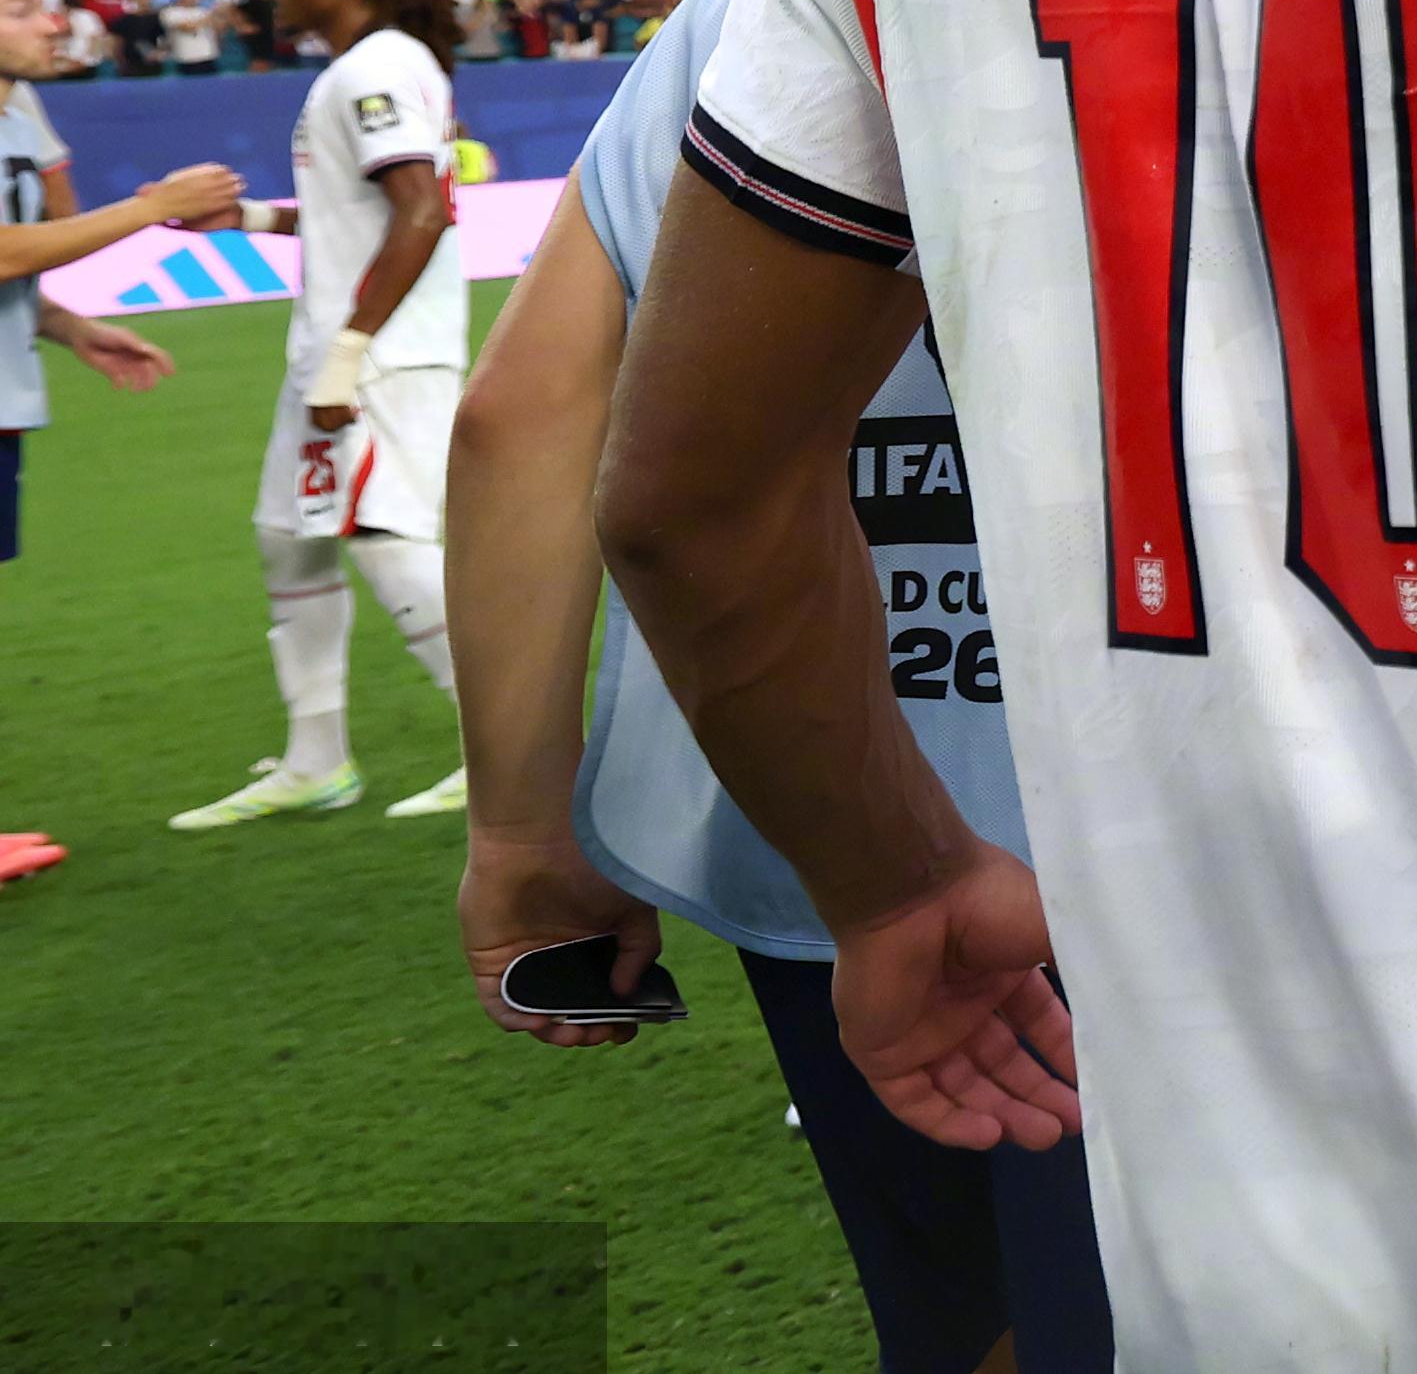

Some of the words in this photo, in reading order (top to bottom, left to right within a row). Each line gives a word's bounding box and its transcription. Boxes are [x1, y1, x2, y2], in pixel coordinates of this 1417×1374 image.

[847, 443, 963, 498] IFA
[938, 570, 989, 615] CU
[889, 627, 1004, 703] 26
